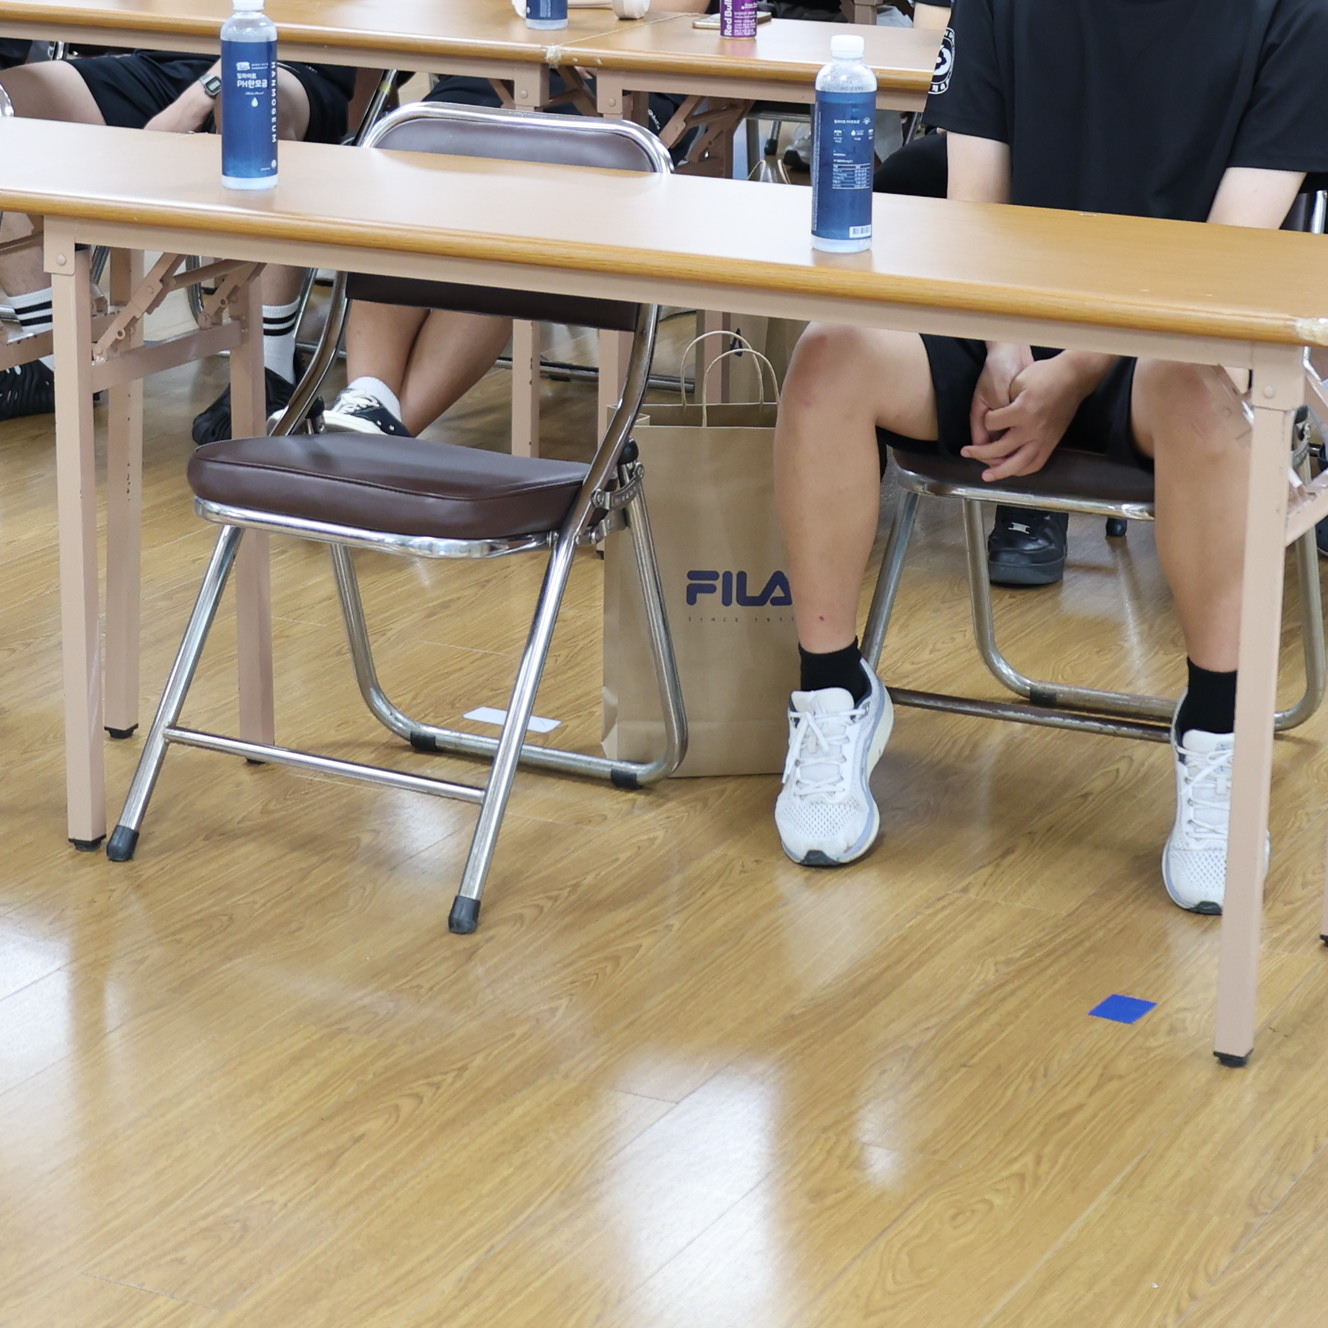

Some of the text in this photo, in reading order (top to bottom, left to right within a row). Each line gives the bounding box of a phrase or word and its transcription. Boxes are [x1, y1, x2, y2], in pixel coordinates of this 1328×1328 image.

[724, 0, 733, 36] Red Bull
[686, 570, 793, 607] FILA
